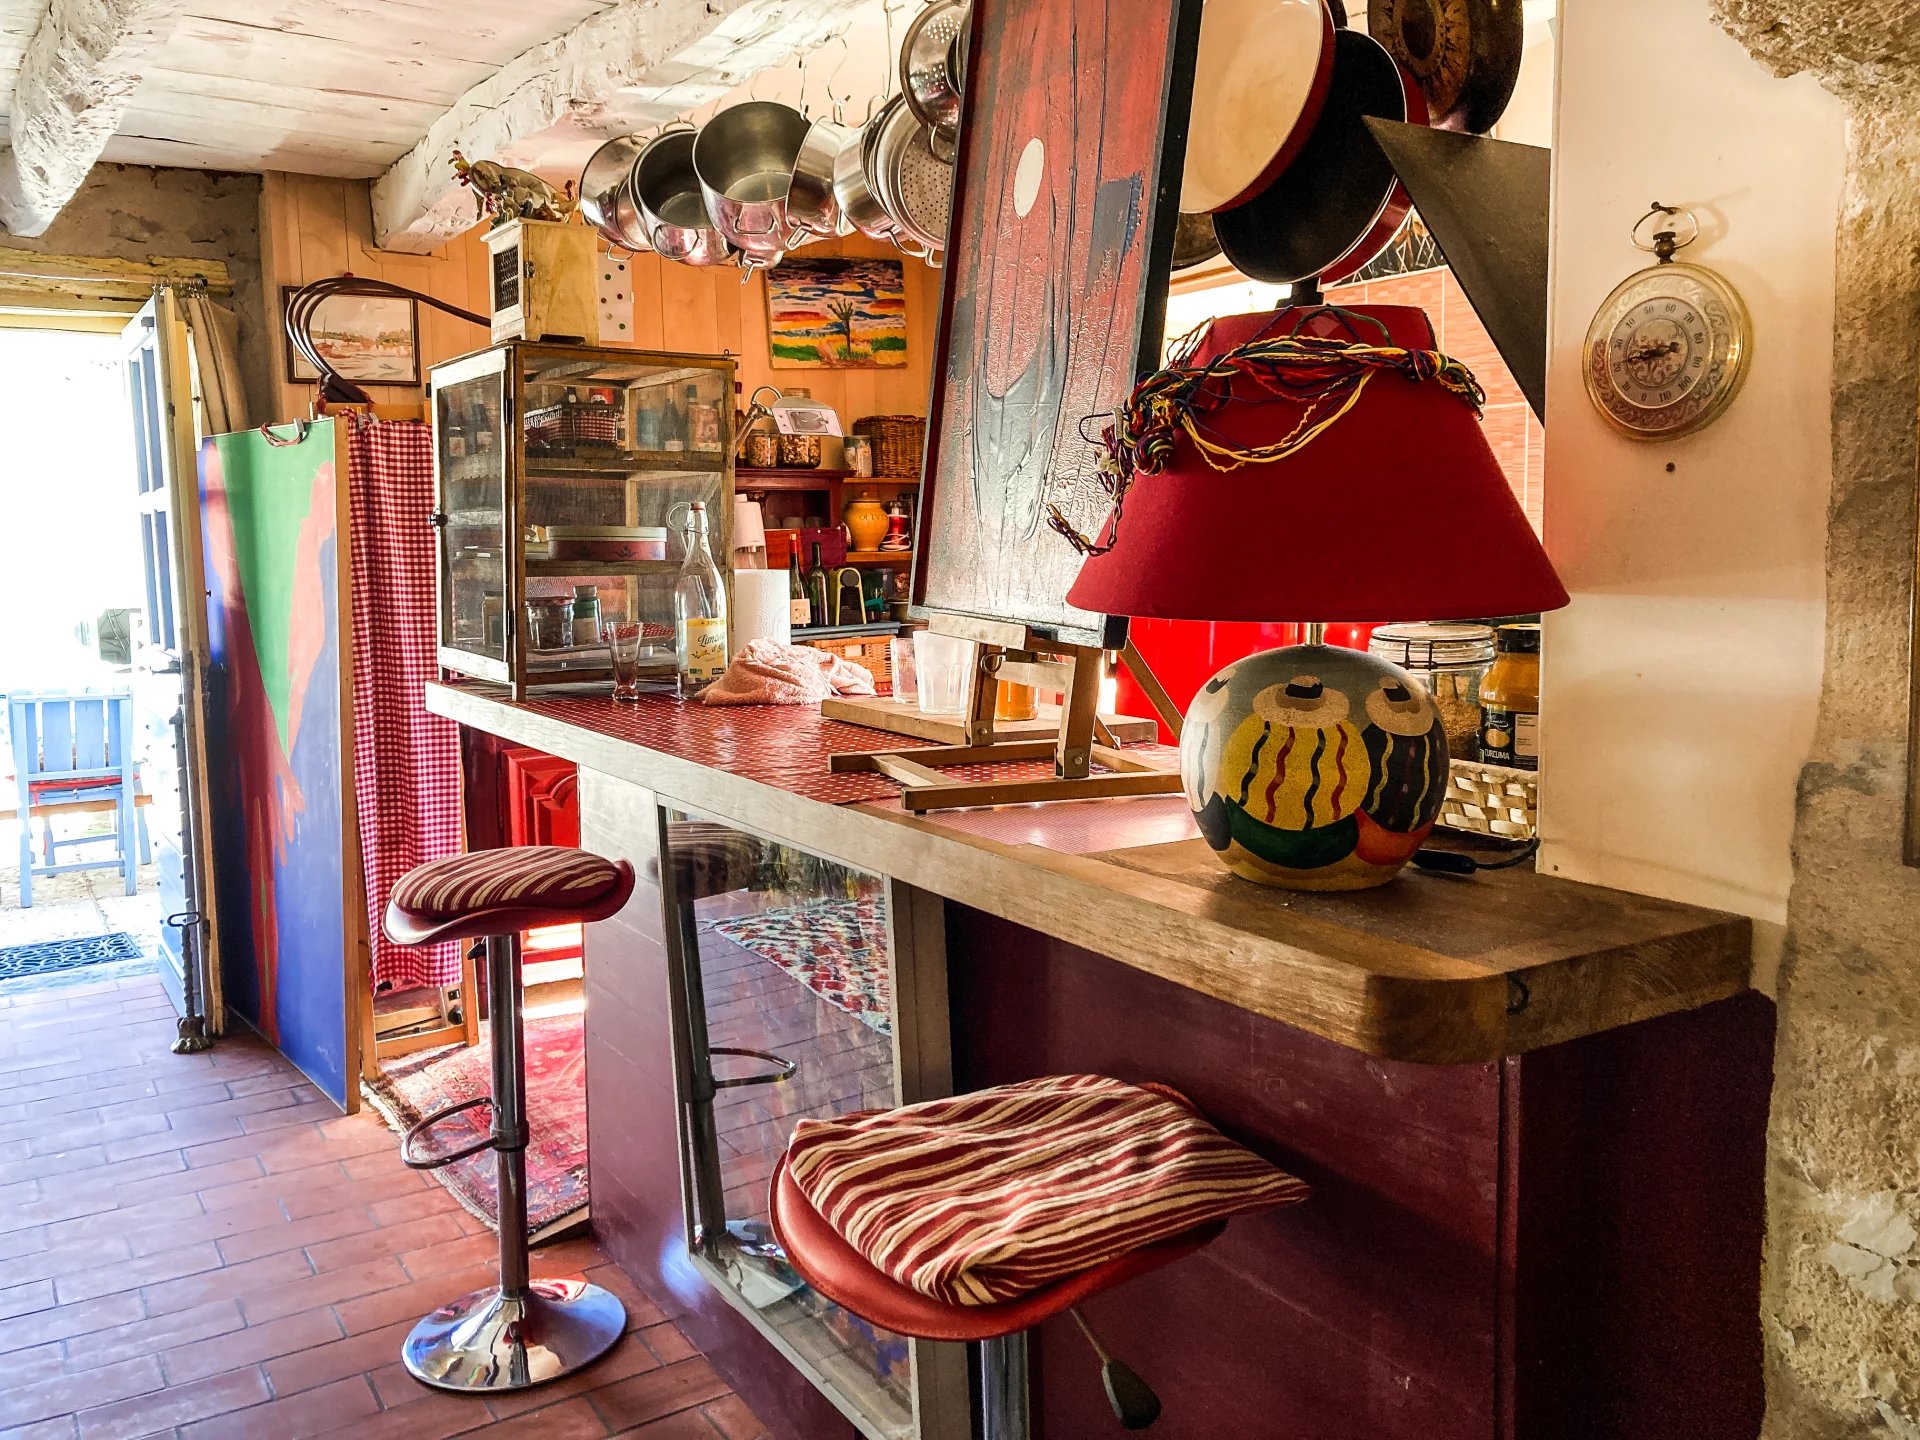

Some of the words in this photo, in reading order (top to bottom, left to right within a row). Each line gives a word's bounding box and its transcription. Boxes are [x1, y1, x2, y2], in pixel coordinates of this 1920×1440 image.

[1665, 303, 1676, 313] 60
[1683, 311, 1695, 324] 70
[1621, 381, 1631, 392] 10
[1677, 375, 1692, 391] 100
[1641, 392, 1647, 402] 0
[1659, 390, 1672, 402] 110
[1485, 749, 1510, 760] CURCUMA
